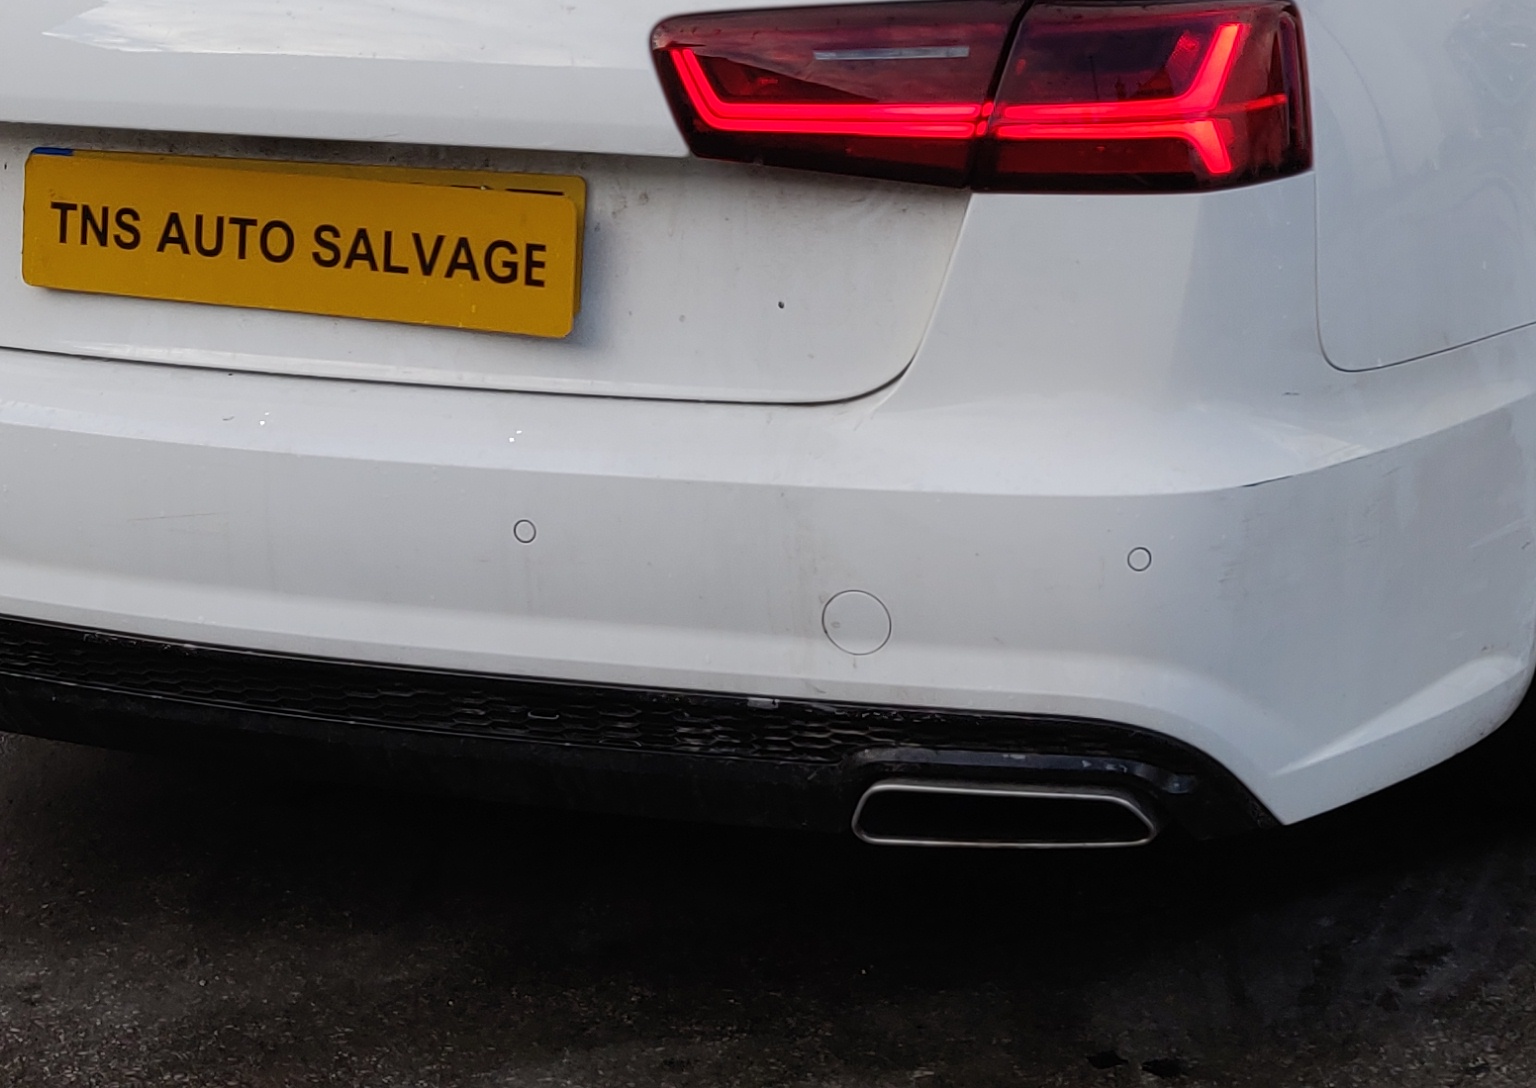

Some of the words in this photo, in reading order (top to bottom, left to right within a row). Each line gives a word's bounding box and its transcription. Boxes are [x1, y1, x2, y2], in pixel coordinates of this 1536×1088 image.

[49, 200, 142, 252] TNS
[155, 211, 296, 264] AUTO
[311, 222, 547, 289] SALVAGE
